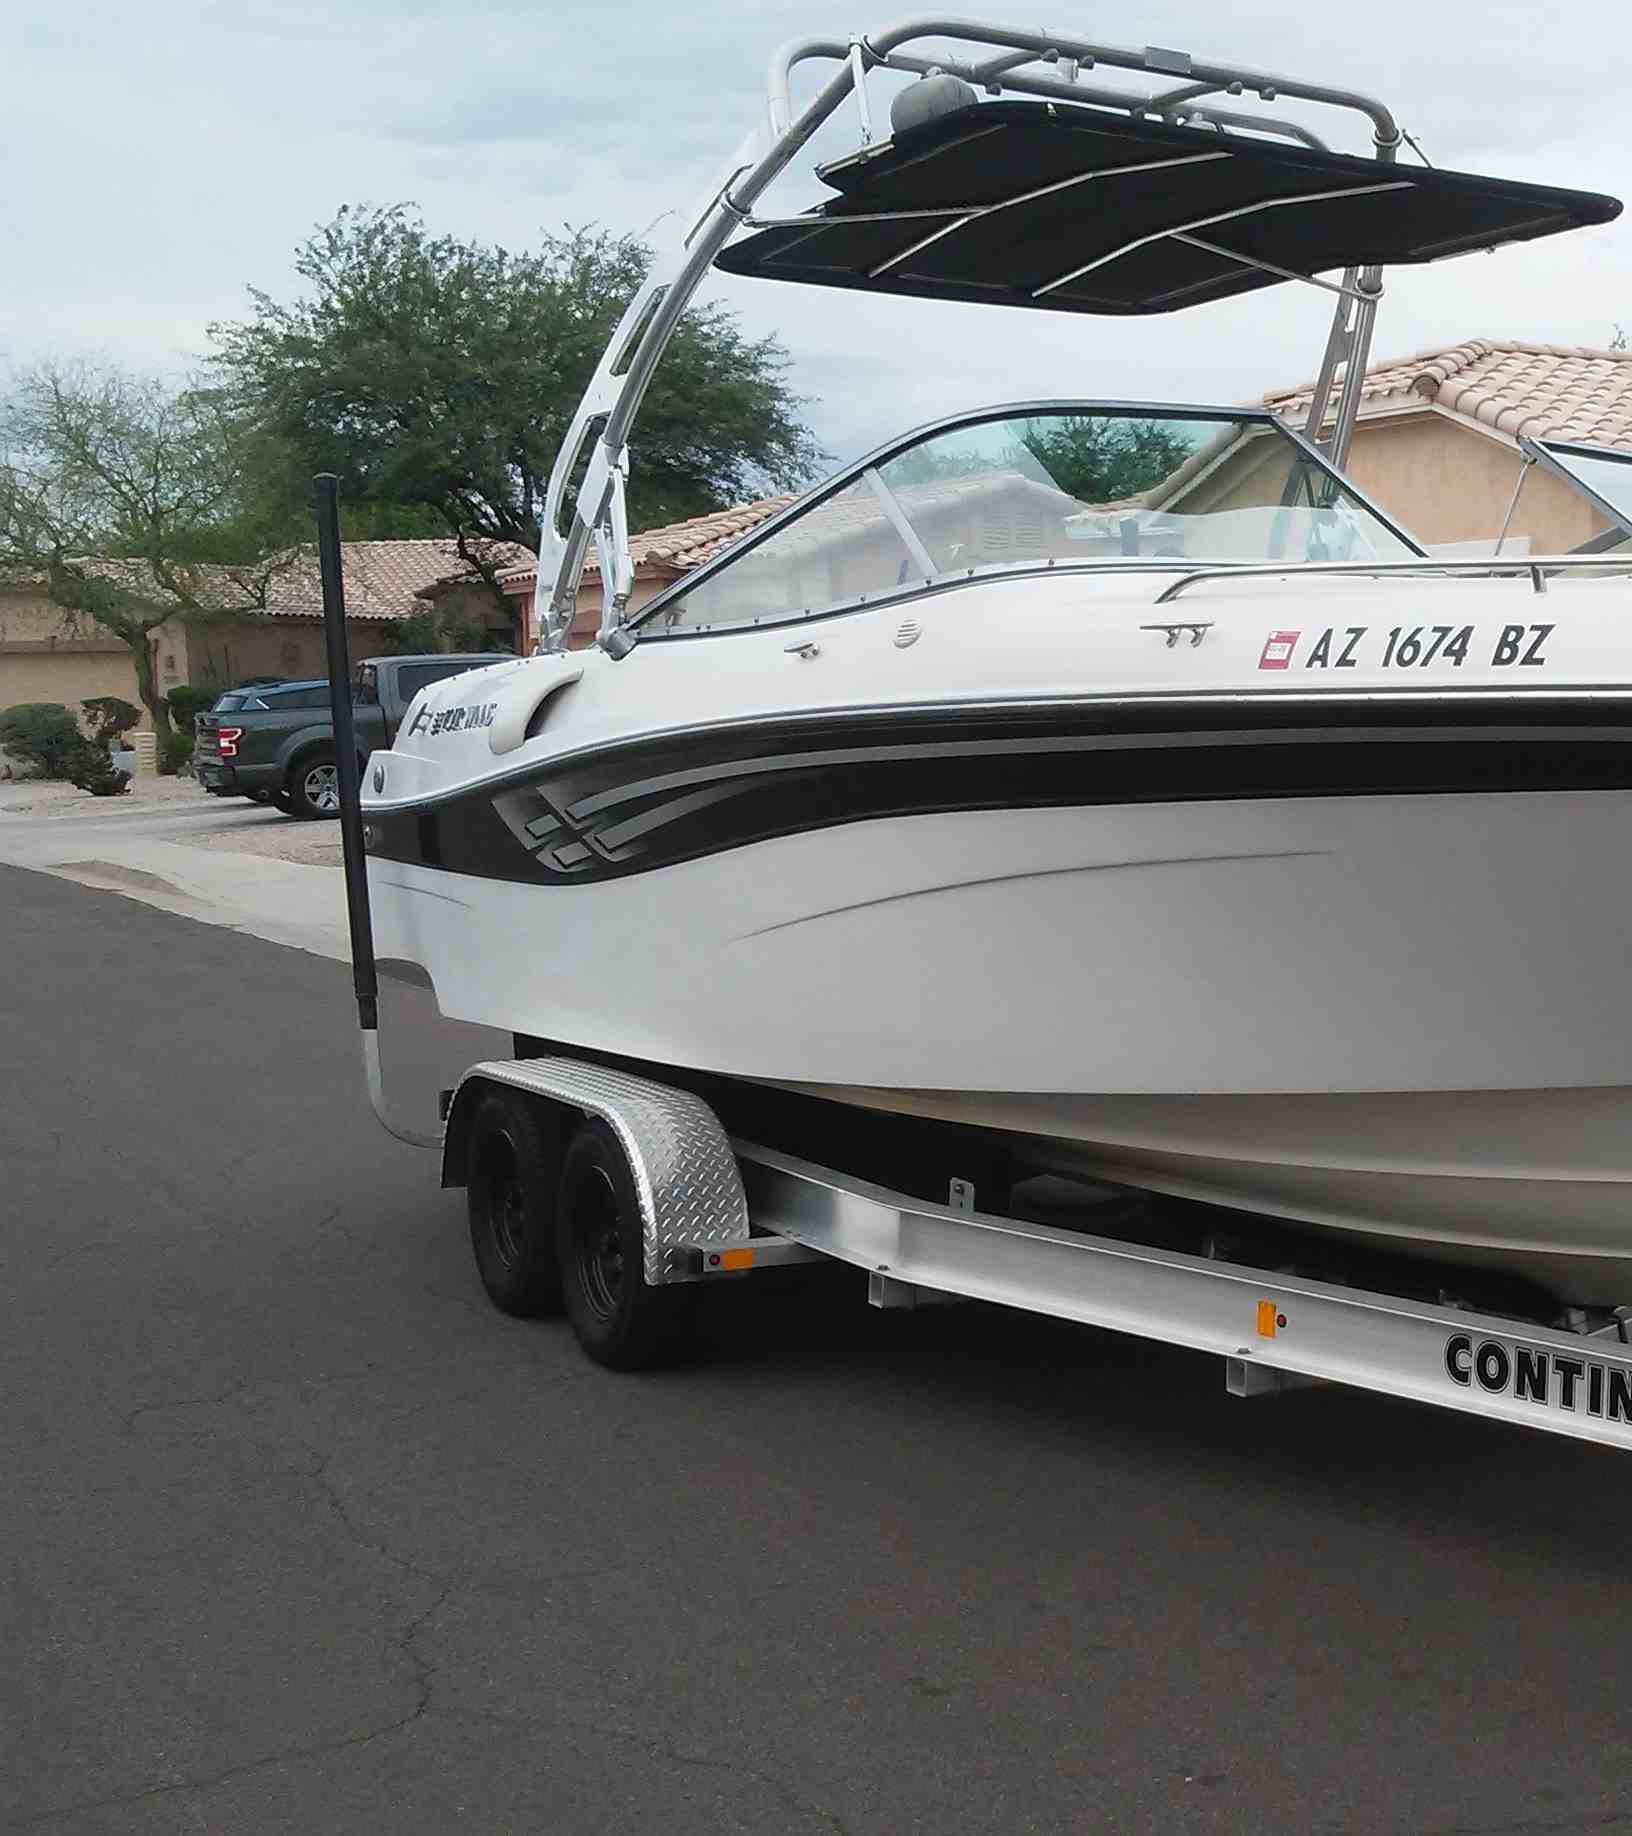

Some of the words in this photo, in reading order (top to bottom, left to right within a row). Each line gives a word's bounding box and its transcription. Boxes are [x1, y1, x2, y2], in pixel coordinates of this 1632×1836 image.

[1305, 627, 1368, 668] AZ
[1382, 625, 1475, 668] 1674
[1491, 624, 1556, 667] BZ
